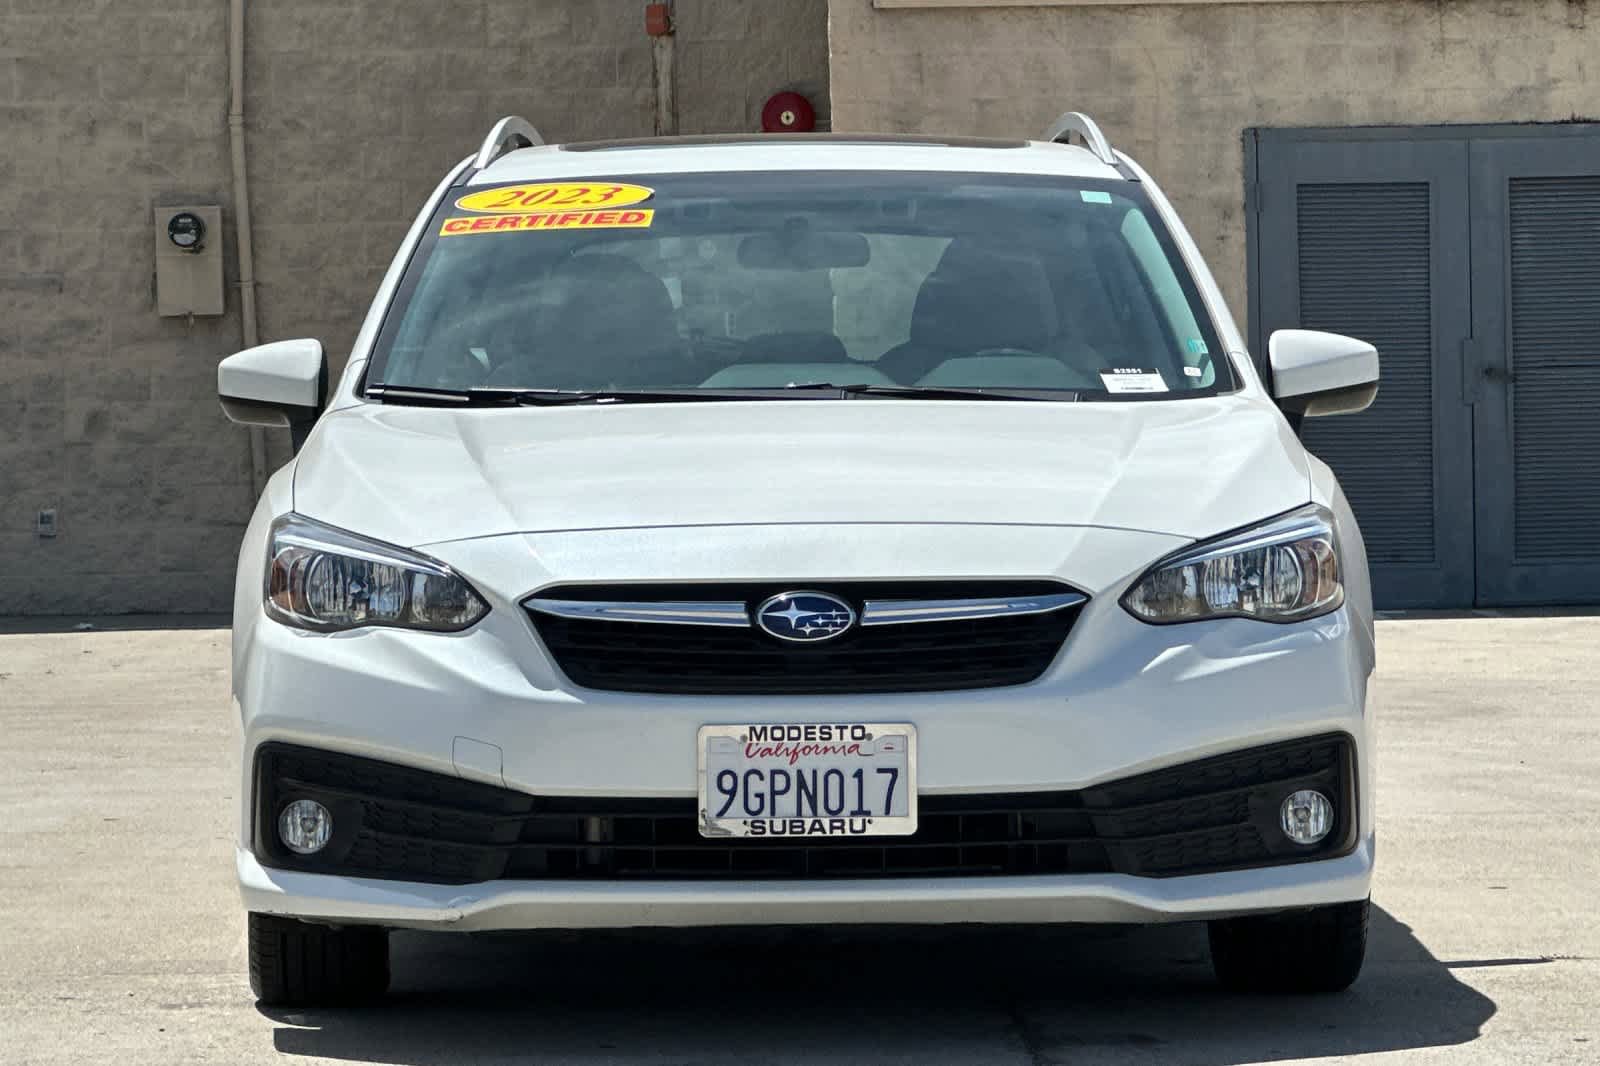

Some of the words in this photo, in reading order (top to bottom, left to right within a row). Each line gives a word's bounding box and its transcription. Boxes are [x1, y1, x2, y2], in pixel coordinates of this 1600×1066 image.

[487, 187, 623, 208] 2023
[444, 211, 645, 232] CERTIFIED
[749, 725, 866, 741] MODESTO
[745, 742, 873, 765] California
[716, 768, 898, 817] 9GPN017
[750, 819, 867, 835] SUBARU
